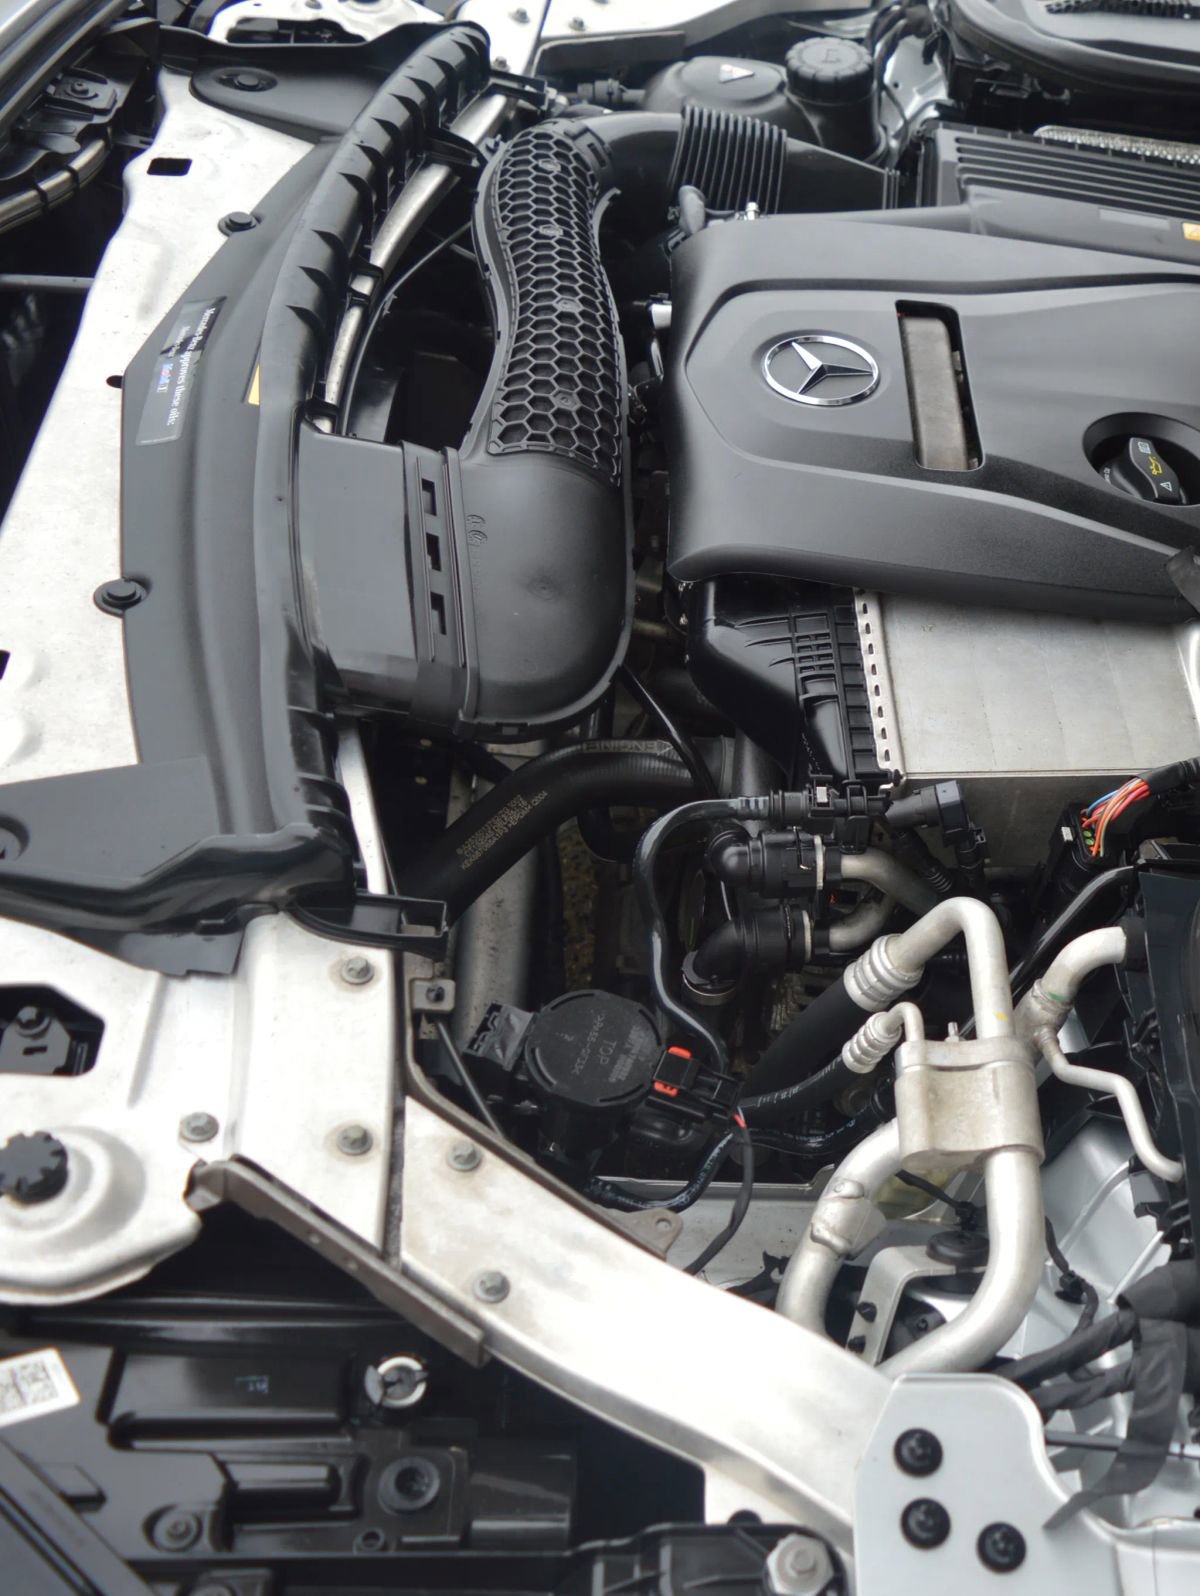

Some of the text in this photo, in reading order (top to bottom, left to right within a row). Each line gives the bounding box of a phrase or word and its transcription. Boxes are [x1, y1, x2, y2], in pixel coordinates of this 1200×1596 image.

[177, 350, 193, 385] approves
[171, 385, 186, 407] these
[583, 740, 657, 754] ENGINE
[598, 1039, 617, 1065] TOP
